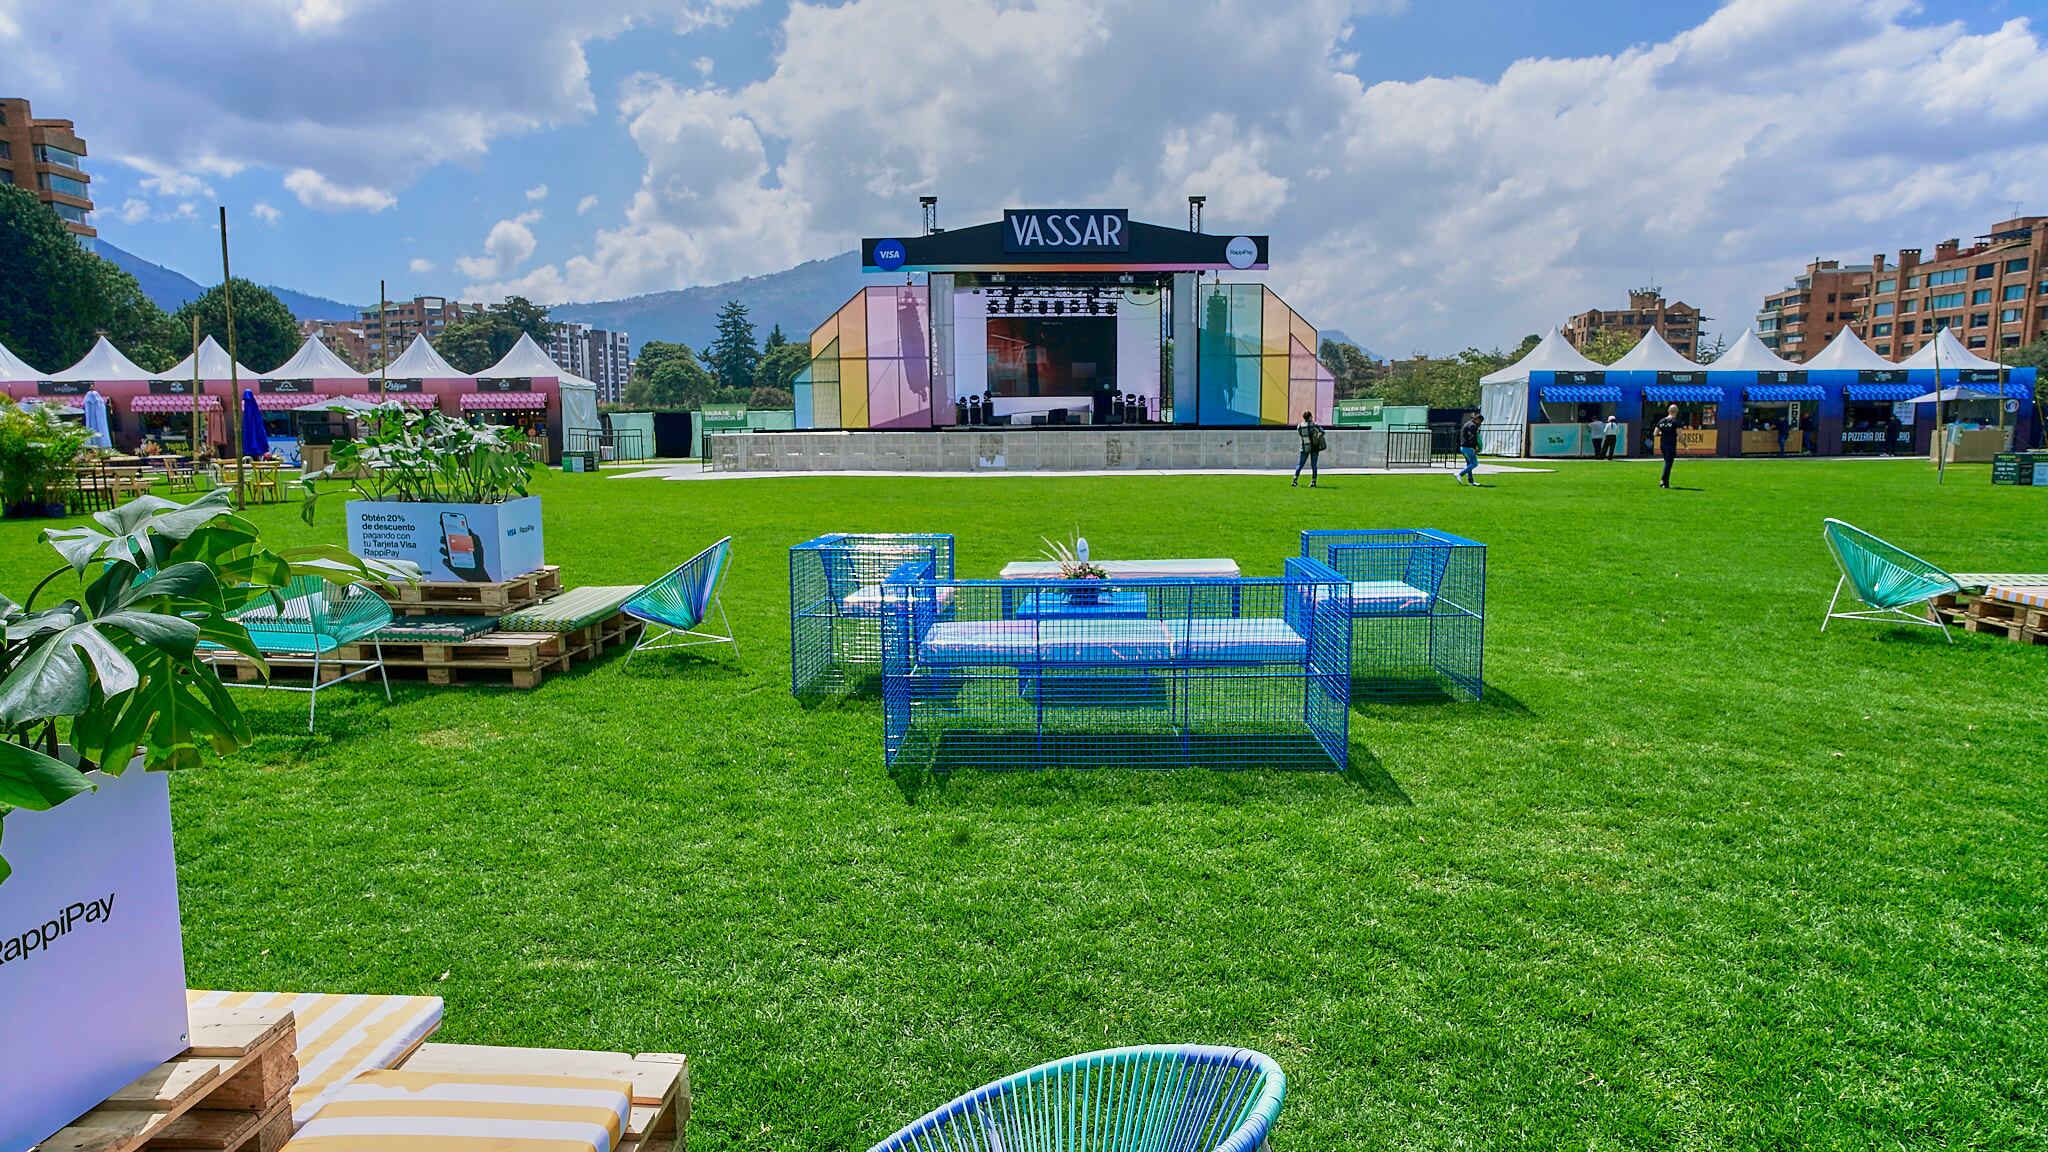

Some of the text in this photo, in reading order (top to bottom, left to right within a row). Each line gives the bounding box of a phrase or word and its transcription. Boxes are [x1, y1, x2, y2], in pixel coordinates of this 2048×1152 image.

[1010, 214, 1122, 246] VASSAR
[879, 250, 900, 259] VISA
[1875, 431, 1886, 441] DEL
[361, 513, 406, 523] Obtén 20%
[373, 523, 416, 531] descuento
[362, 532, 395, 540] pagando
[373, 541, 399, 549] Tarjeta
[400, 541, 417, 549] Visa
[364, 549, 400, 558] RappiPay
[0, 893, 115, 966] appiPay
